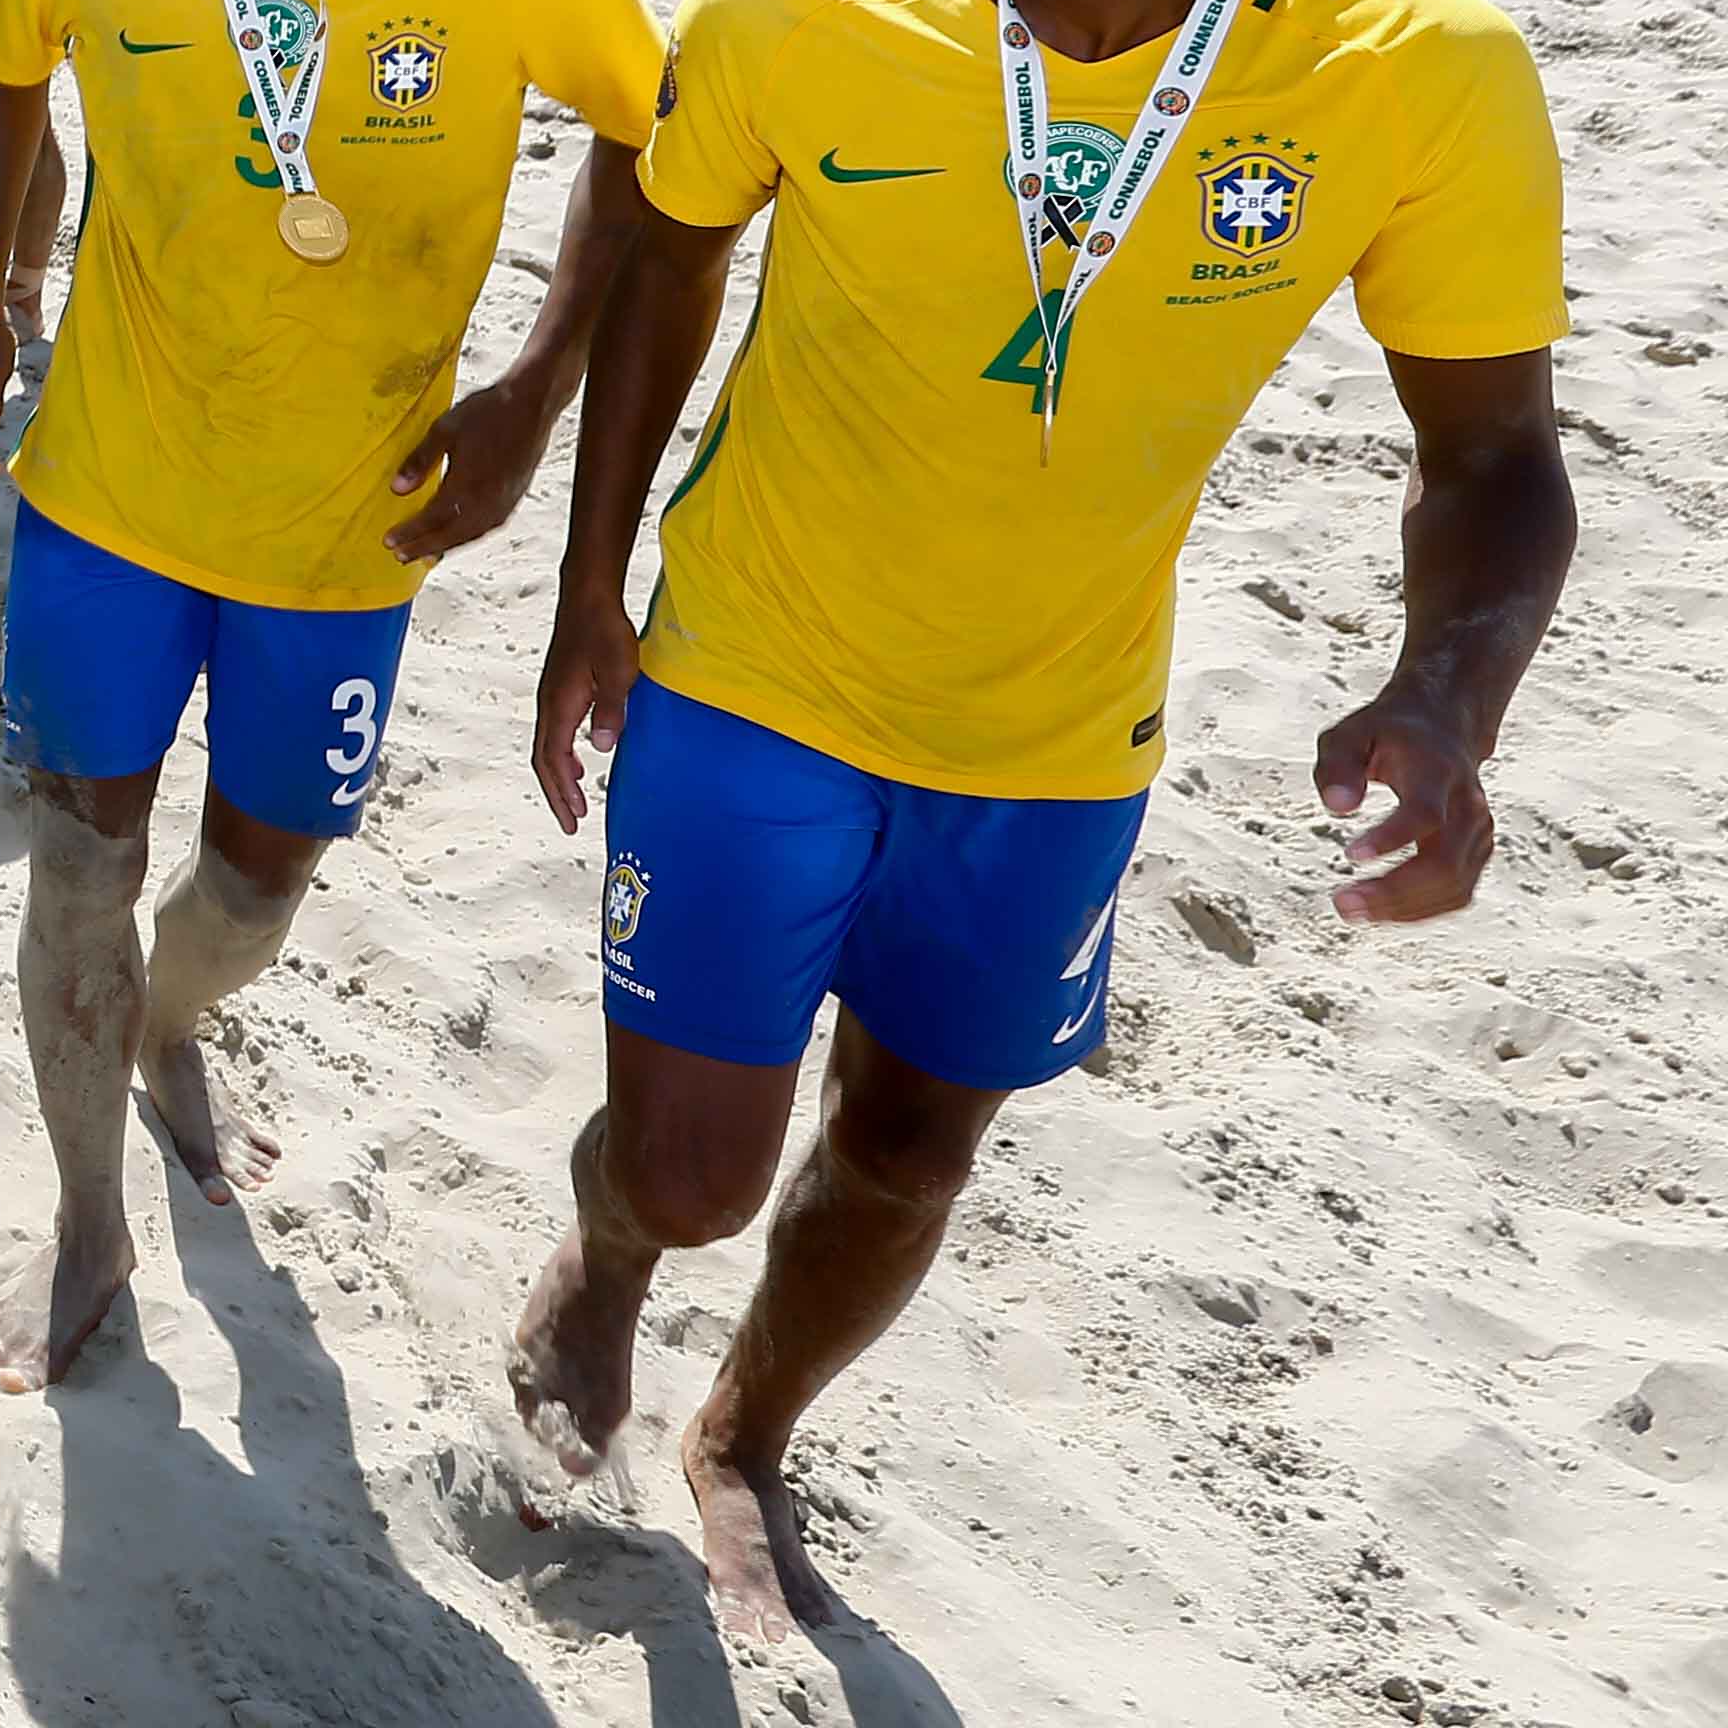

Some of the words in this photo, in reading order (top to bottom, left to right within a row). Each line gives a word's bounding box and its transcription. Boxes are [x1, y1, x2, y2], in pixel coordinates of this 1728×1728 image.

[394, 66, 420, 76] CBF
[289, 51, 319, 121] CONMEBOL
[365, 115, 436, 129] BRASIL
[1012, 61, 1035, 161] CONMEBOL
[340, 135, 386, 144] BEACH
[390, 133, 445, 145] SOCCER
[1108, 125, 1166, 220] CONMEBOL
[1235, 197, 1272, 208] CBF
[1191, 259, 1280, 280] BRASIL
[1166, 294, 1226, 304] BEACH
[1231, 278, 1299, 300] SOCCER
[980, 288, 1075, 415] 4
[326, 678, 377, 774] 3
[609, 970, 657, 1002] SOCCER
